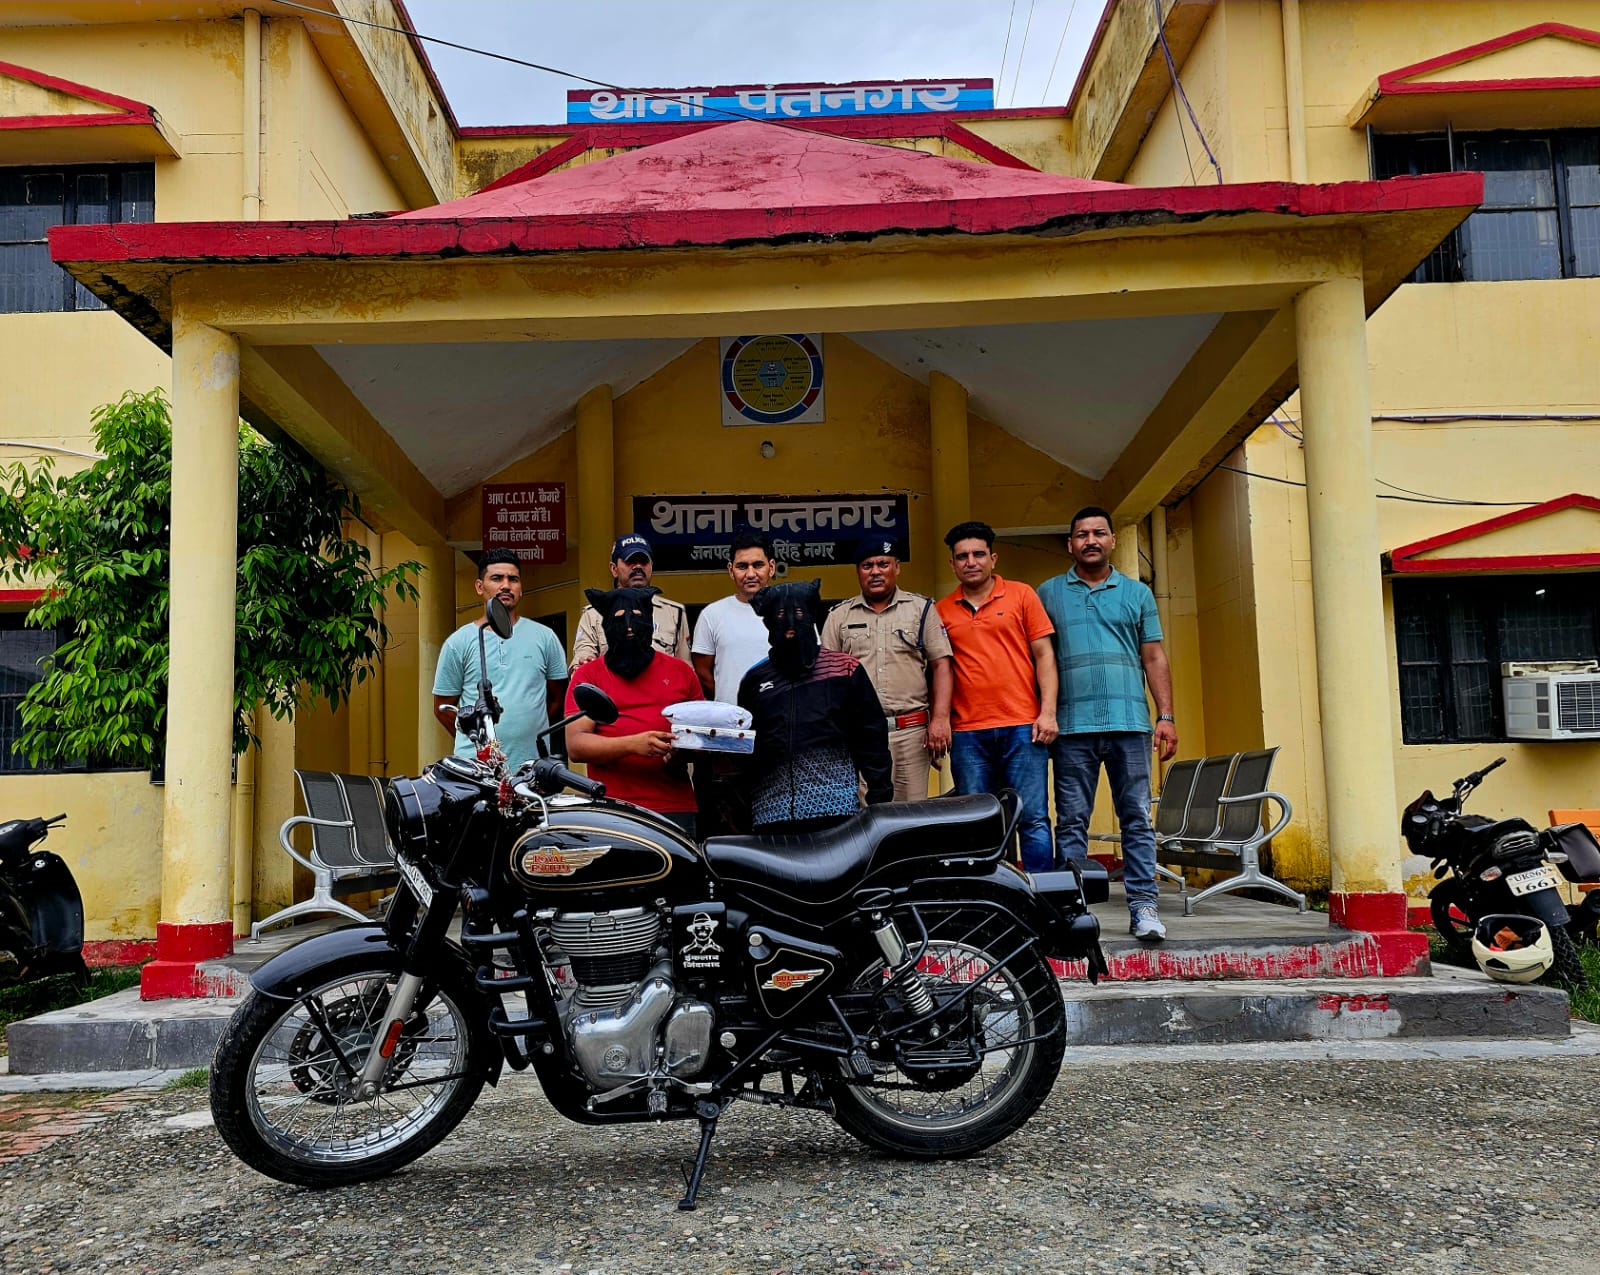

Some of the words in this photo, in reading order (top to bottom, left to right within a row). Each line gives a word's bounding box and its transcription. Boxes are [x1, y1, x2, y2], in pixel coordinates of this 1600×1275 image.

[589, 91, 709, 120] थाना
[735, 83, 966, 116] पंतनगर
[487, 492, 505, 505] आप
[505, 491, 538, 505] C.C.T.V.
[538, 487, 560, 503] कैमरे
[496, 507, 508, 523] की
[508, 510, 530, 523] नजर
[651, 500, 738, 534] थाना
[744, 499, 896, 533] पन्तनगर
[488, 526, 509, 542] बिना
[509, 526, 537, 542] हेलमेट
[537, 528, 560, 541] वाहन
[690, 544, 732, 561] जनपद
[803, 541, 836, 560] नगर
[533, 855, 566, 863] ROYAL
[1515, 877, 1557, 894] 1661
